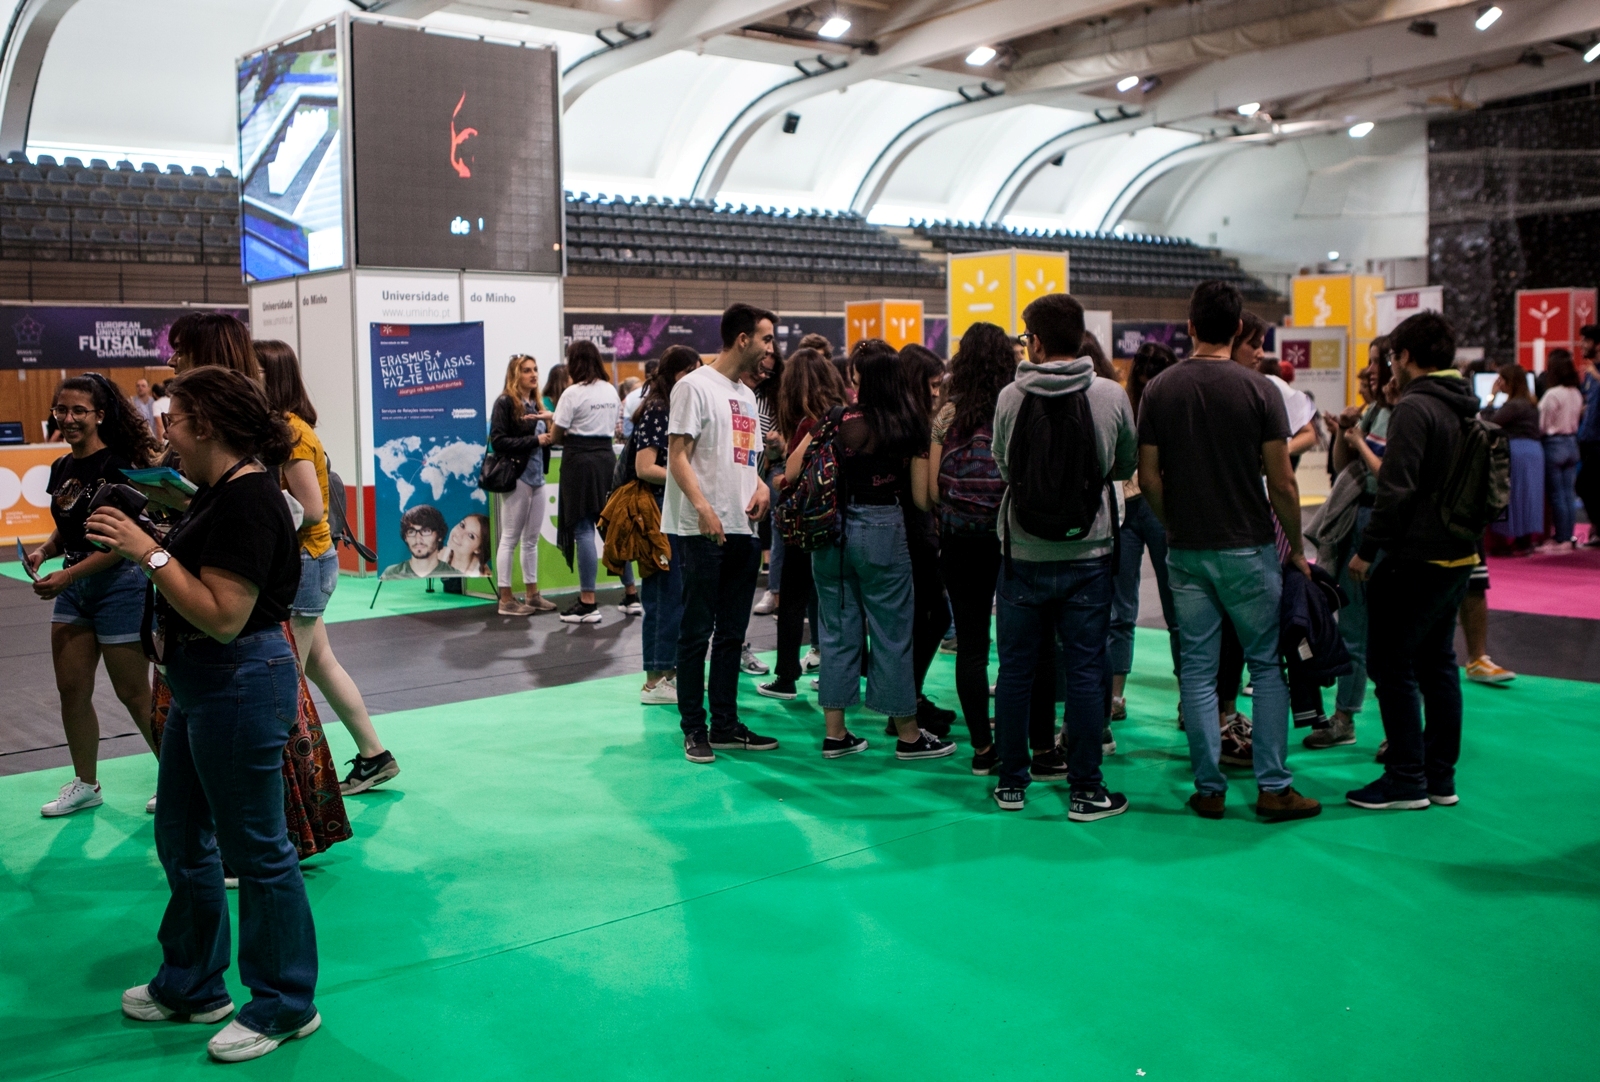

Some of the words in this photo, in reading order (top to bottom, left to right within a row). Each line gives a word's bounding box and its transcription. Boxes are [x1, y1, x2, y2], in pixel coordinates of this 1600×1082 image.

[382, 290, 450, 302] Universidade
[470, 292, 482, 303] do
[485, 293, 516, 303] Minho
[262, 299, 293, 312] Universidade
[302, 296, 309, 306] do
[310, 294, 327, 305] Minho
[382, 308, 450, 319] www.uminho.pt
[95, 321, 141, 329] EUROPEAN
[95, 328, 152, 337] UNIVERSITIES
[79, 336, 143, 351] FUTSAL
[97, 349, 161, 358] CHAMPIONSHIP
[380, 350, 431, 367] ERASMUS
[407, 362, 422, 374] TE
[383, 373, 424, 389] FAZ-TE
[427, 368, 458, 382] VOAR!
[842, 411, 864, 421] Barbie
[872, 474, 897, 487] Barbie
[1003, 792, 1022, 801] NIKE
[1070, 803, 1084, 812] IKE
